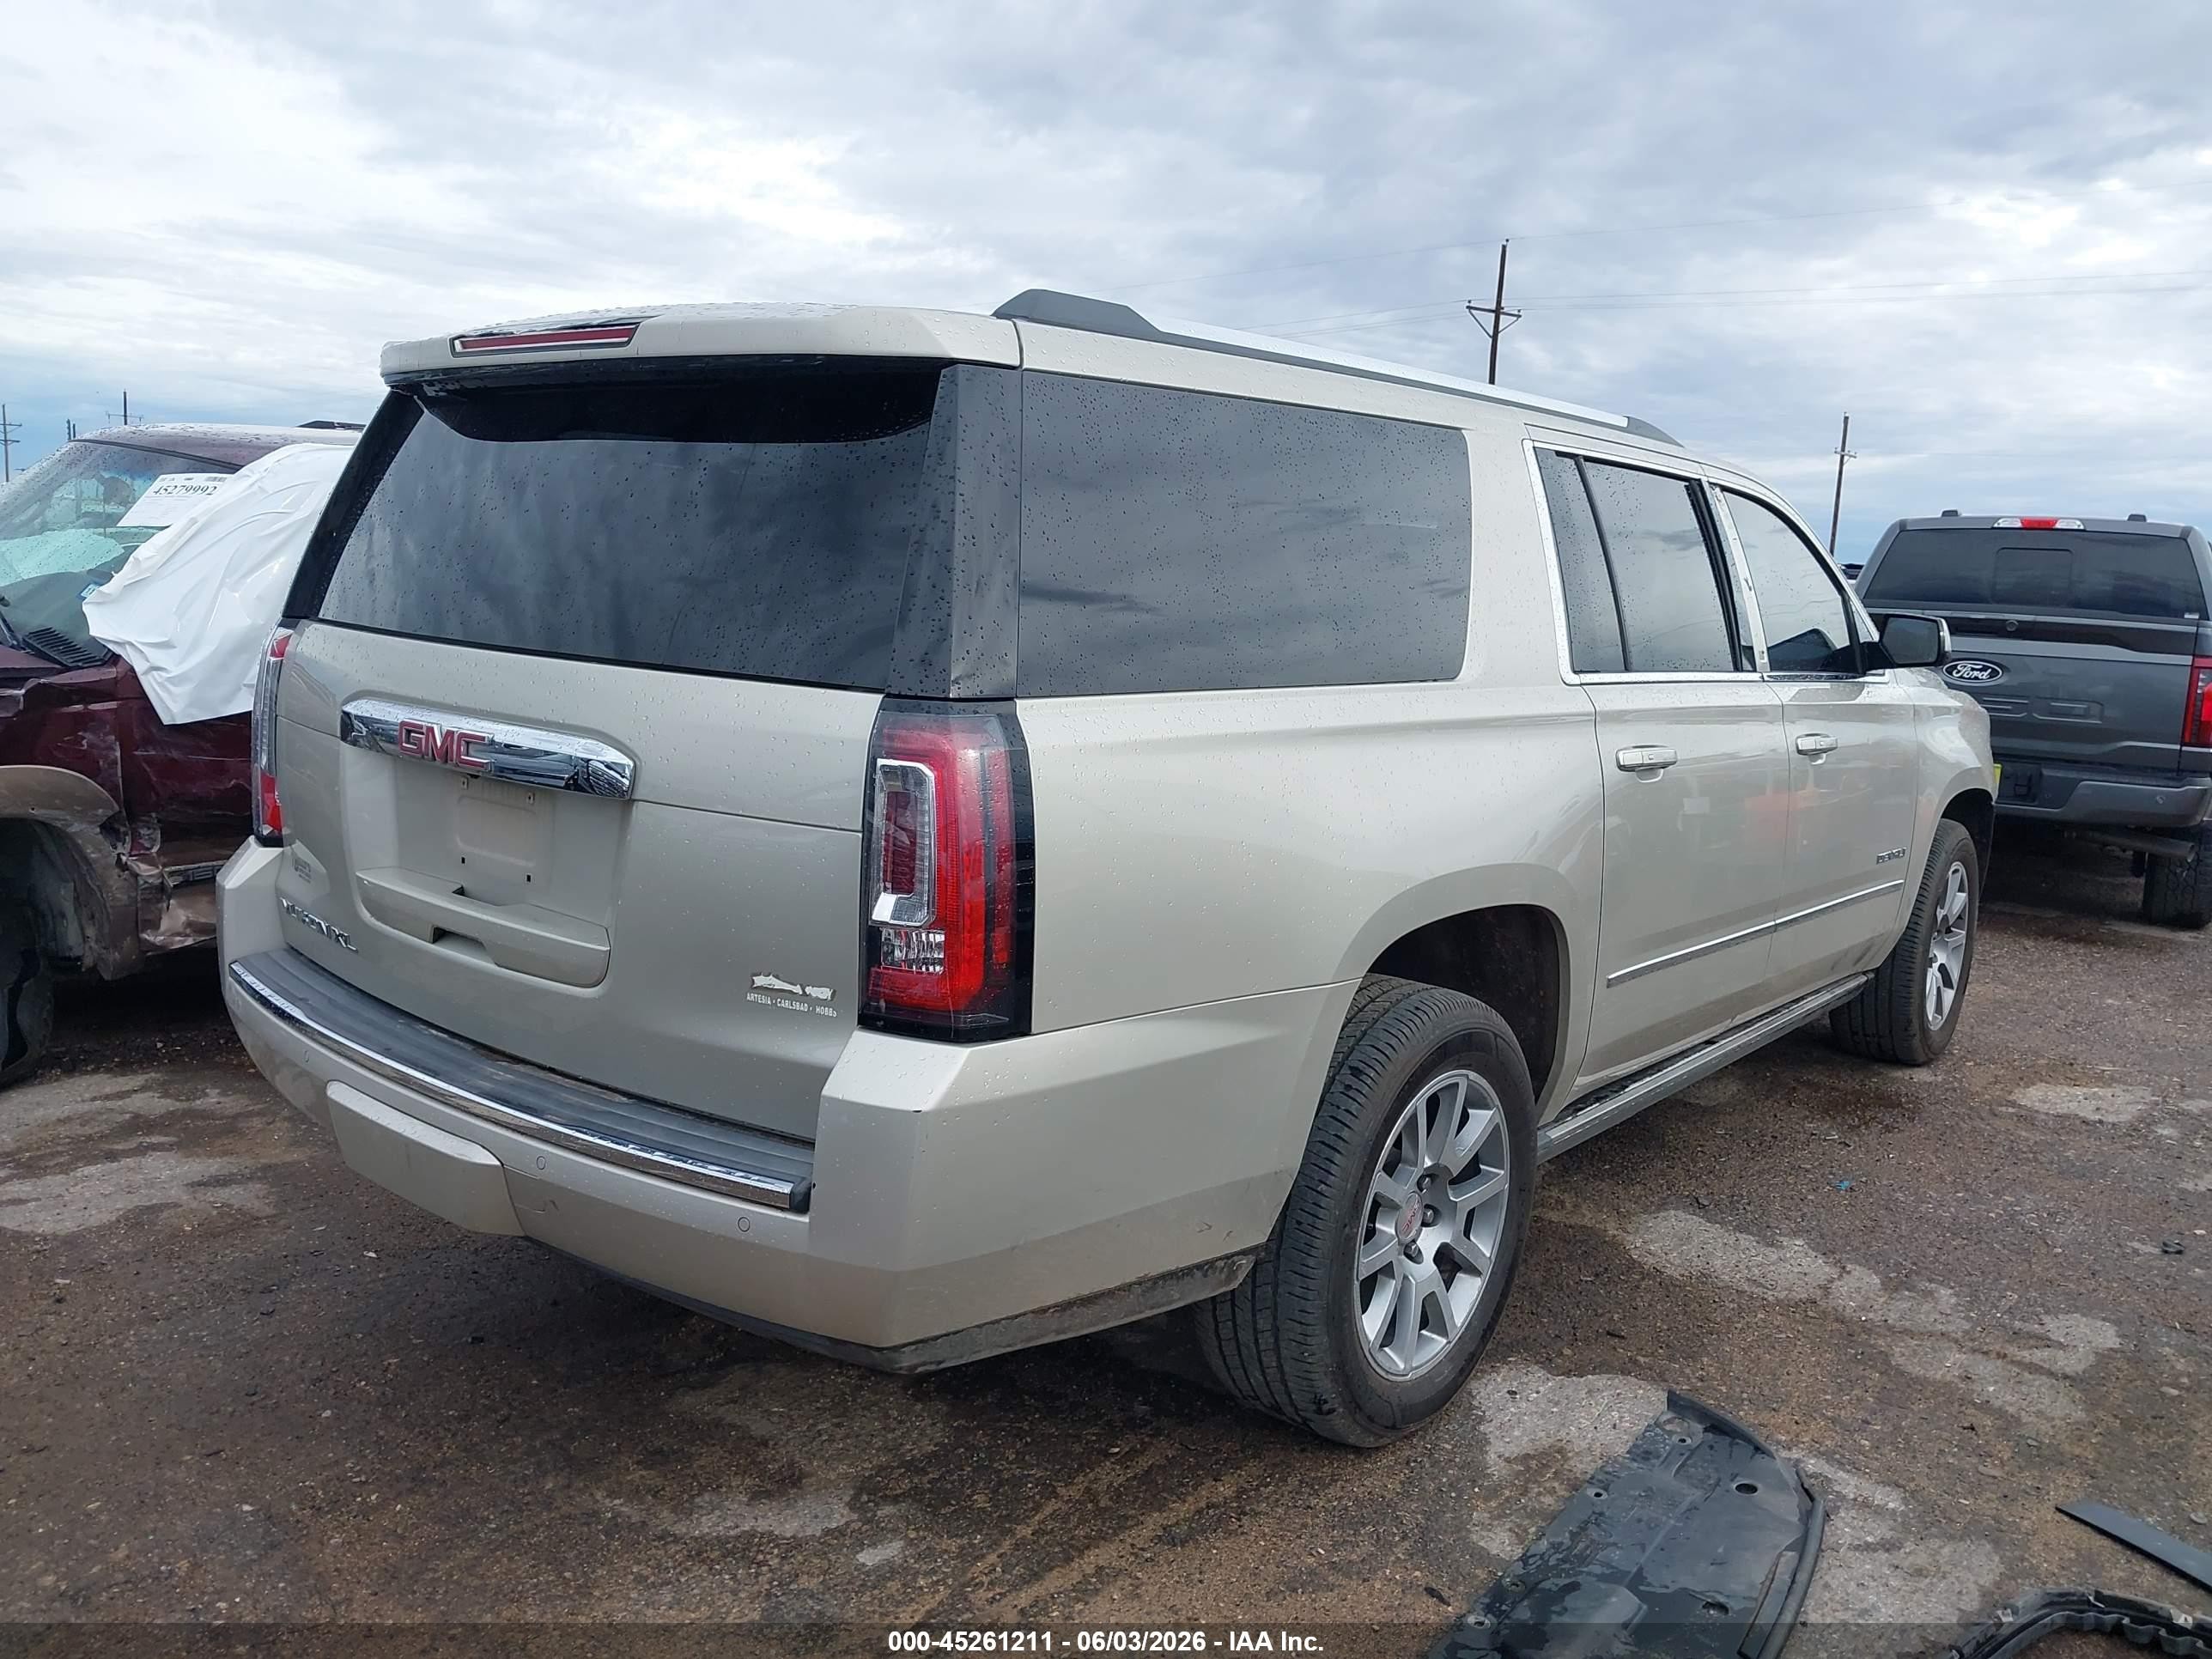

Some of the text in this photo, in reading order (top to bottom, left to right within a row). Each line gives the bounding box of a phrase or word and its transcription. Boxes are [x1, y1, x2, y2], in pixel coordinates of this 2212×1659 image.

[153, 484, 218, 495] 45279992
[1953, 663, 1992, 679] Ford
[398, 718, 494, 772] GMC
[746, 993, 771, 1005] ARTESIA
[776, 999, 808, 1012] CARLSBAD
